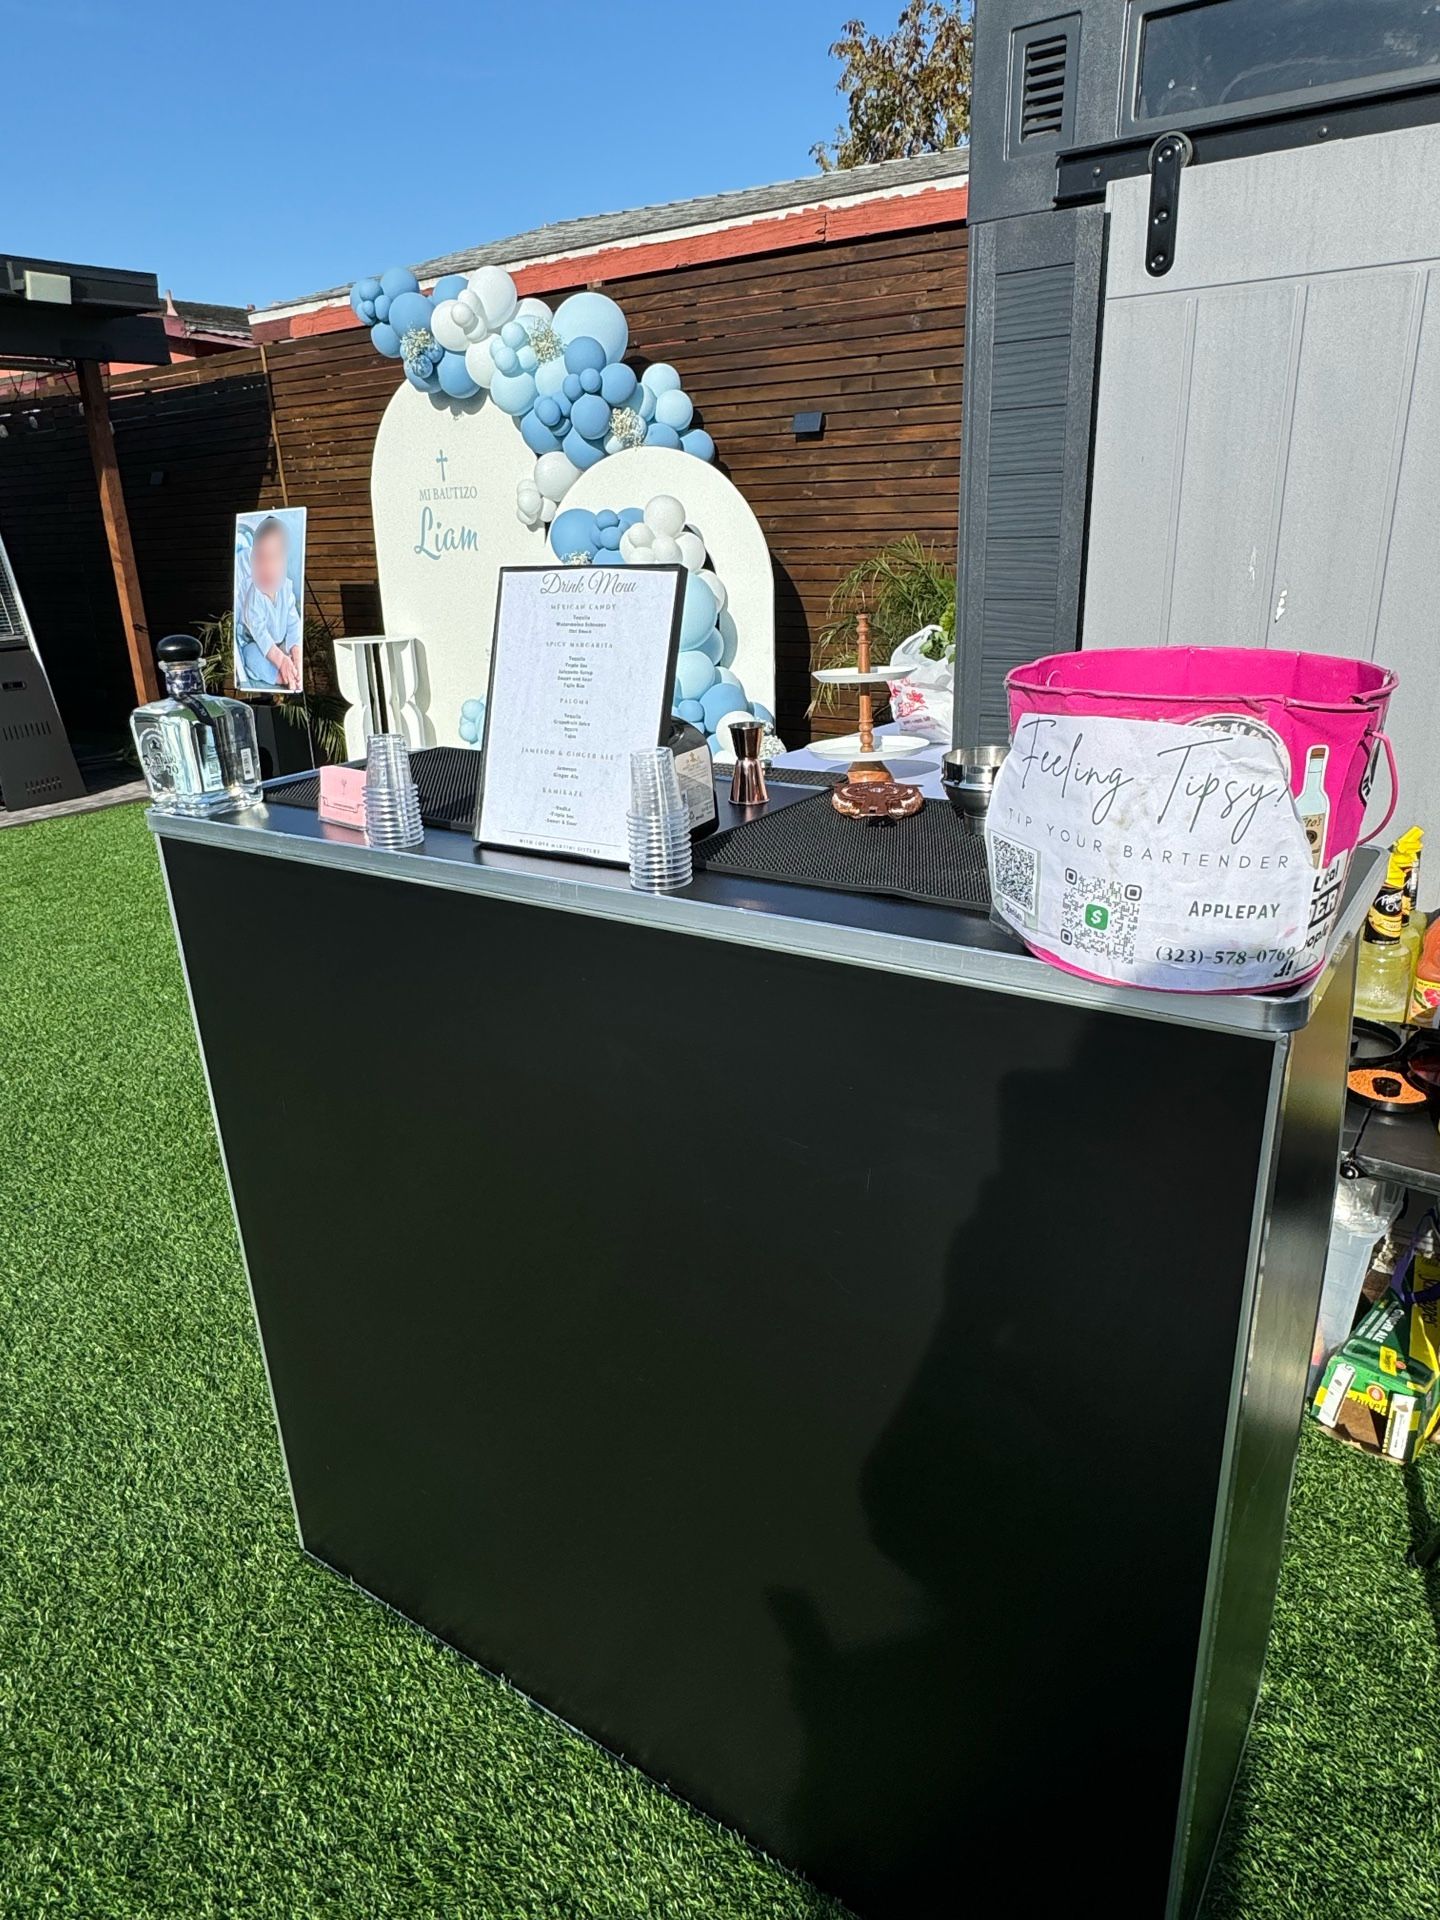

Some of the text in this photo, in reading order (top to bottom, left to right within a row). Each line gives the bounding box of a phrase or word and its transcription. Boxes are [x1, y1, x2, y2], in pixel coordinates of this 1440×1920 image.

[419, 486, 478, 501] MI BAUTIZO
[414, 506, 479, 560] Liam
[540, 570, 638, 597] Drink Menu
[521, 747, 555, 755] JAMESON
[566, 751, 597, 759] GINGER
[1022, 717, 1134, 825] Feeling
[542, 787, 582, 797] KAMIKAZE
[1008, 806, 1289, 870] TIP YOUR BARTENDER
[1156, 945, 1296, 965] (323)-578-0769
[1372, 1329, 1389, 1344] ALE
